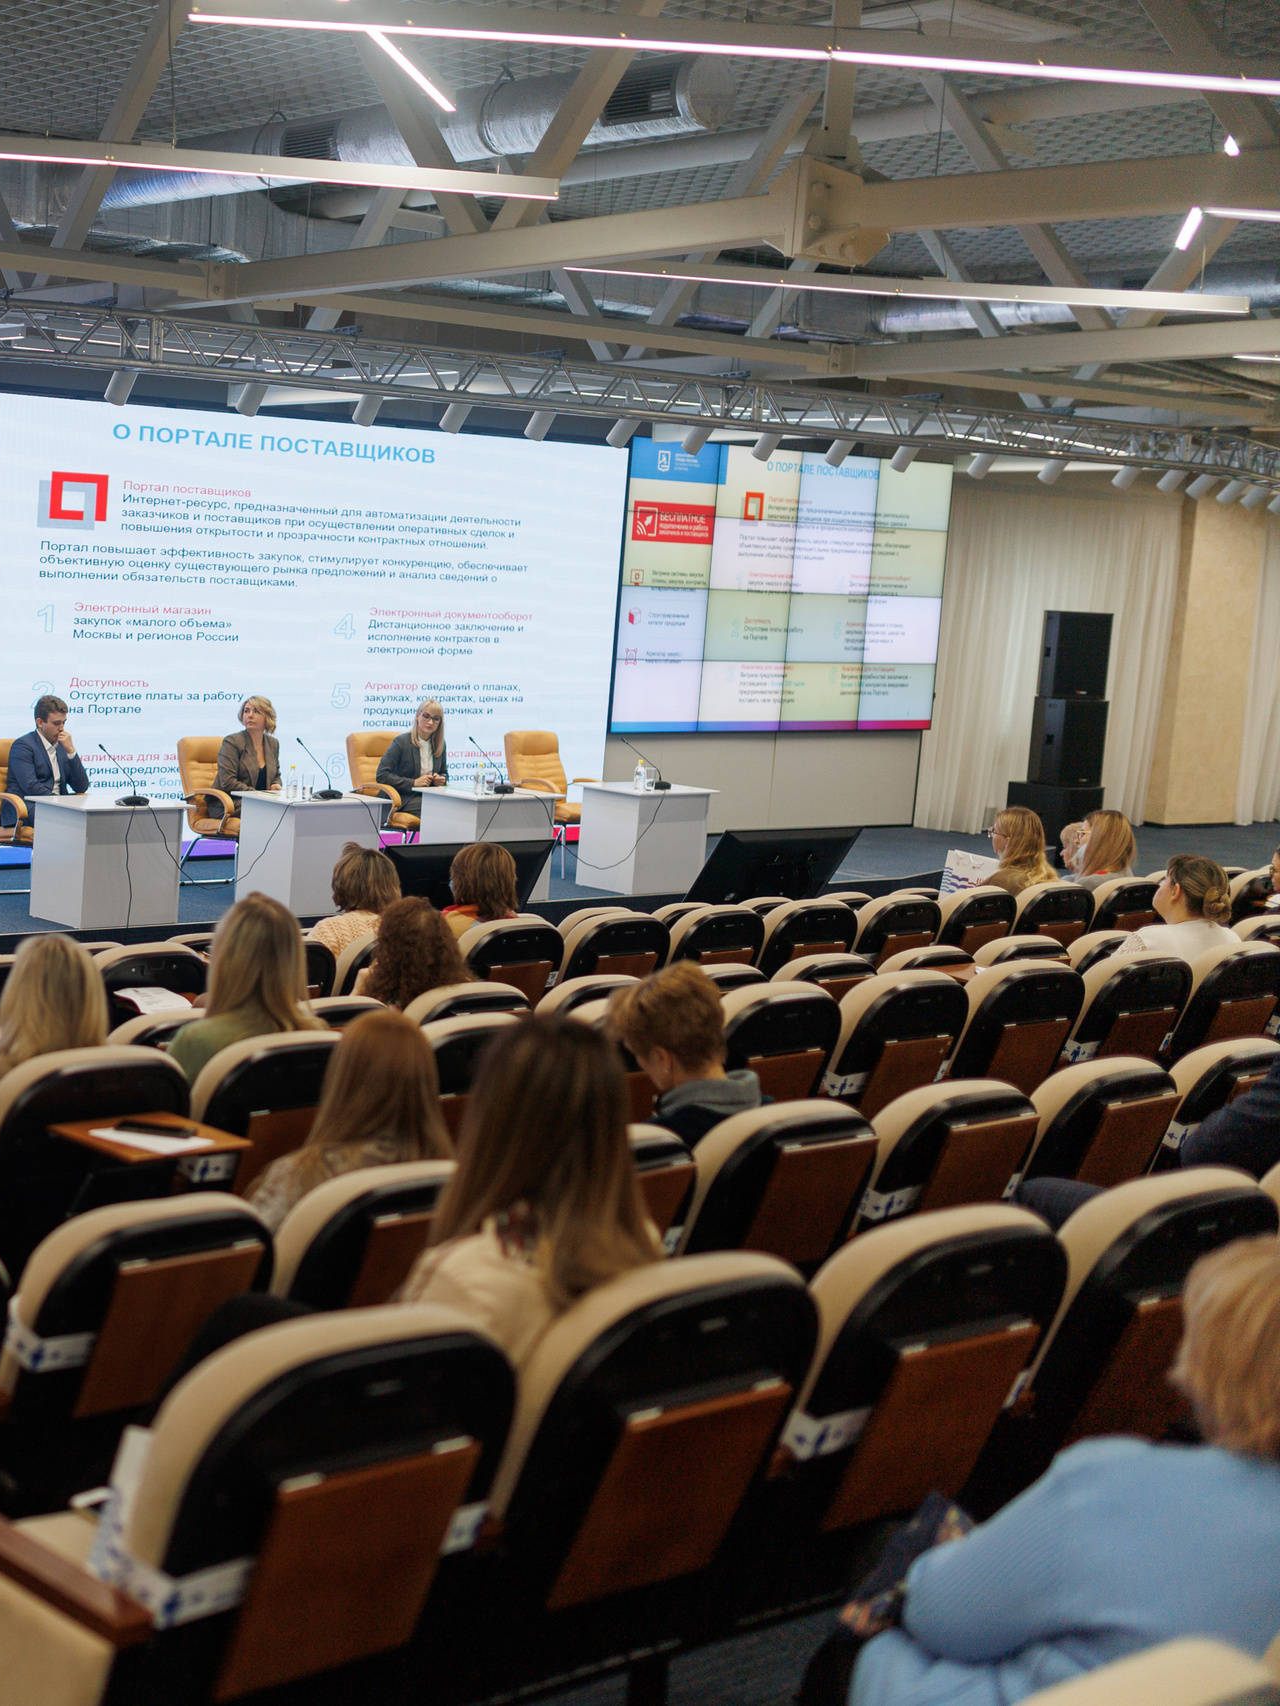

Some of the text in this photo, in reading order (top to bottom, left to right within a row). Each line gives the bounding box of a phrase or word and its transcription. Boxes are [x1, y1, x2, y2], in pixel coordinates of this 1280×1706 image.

[112, 422, 434, 464] О ПОРТАЛЕ ПОСТАВЩИКОВ
[766, 461, 880, 480] О ПОРТАЛЕ ПОСТАВЩИКОВ
[122, 480, 251, 497] Портал поставщиков
[122, 494, 520, 526] Интернет-ресурс, предназначенный для автоматизации деятельности
[121, 509, 189, 520] заказчиков
[204, 514, 281, 525] поставщиков
[284, 518, 305, 528] при
[308, 520, 395, 532] осуществлении
[398, 525, 467, 536] оперативных
[470, 529, 506, 539] сделок
[120, 523, 192, 534] повышения
[195, 527, 263, 538] открытости
[277, 531, 355, 543] прозрачности
[358, 536, 425, 546] контрактных
[428, 539, 489, 549] отношений.
[40, 540, 528, 572] Портал повышает эффективность закупок, стимулирует конкуренцию, обеспечивает
[74, 602, 211, 615] Электронный магазин
[369, 607, 533, 621] Электронный документооборот
[36, 604, 55, 633] 1
[73, 617, 232, 628] закупок «малого объема»
[334, 612, 356, 640] 4
[367, 619, 451, 630] Дистанционное
[454, 623, 515, 632] заключение
[72, 628, 122, 639] Москвы
[136, 632, 192, 641] регионов
[196, 631, 238, 642] России
[367, 634, 431, 642] исполнение
[434, 635, 490, 643] контрактов
[366, 646, 472, 656] электронной форме
[69, 677, 149, 688] Доступность
[364, 682, 418, 691] Агрегатор
[420, 683, 470, 691] сведений
[482, 684, 521, 693] планах,
[69, 690, 142, 700] Отсутствие
[145, 692, 183, 700] платы
[203, 691, 244, 702] работу
[330, 682, 352, 710] 5
[87, 704, 141, 714] Портале
[326, 752, 346, 778] 6
